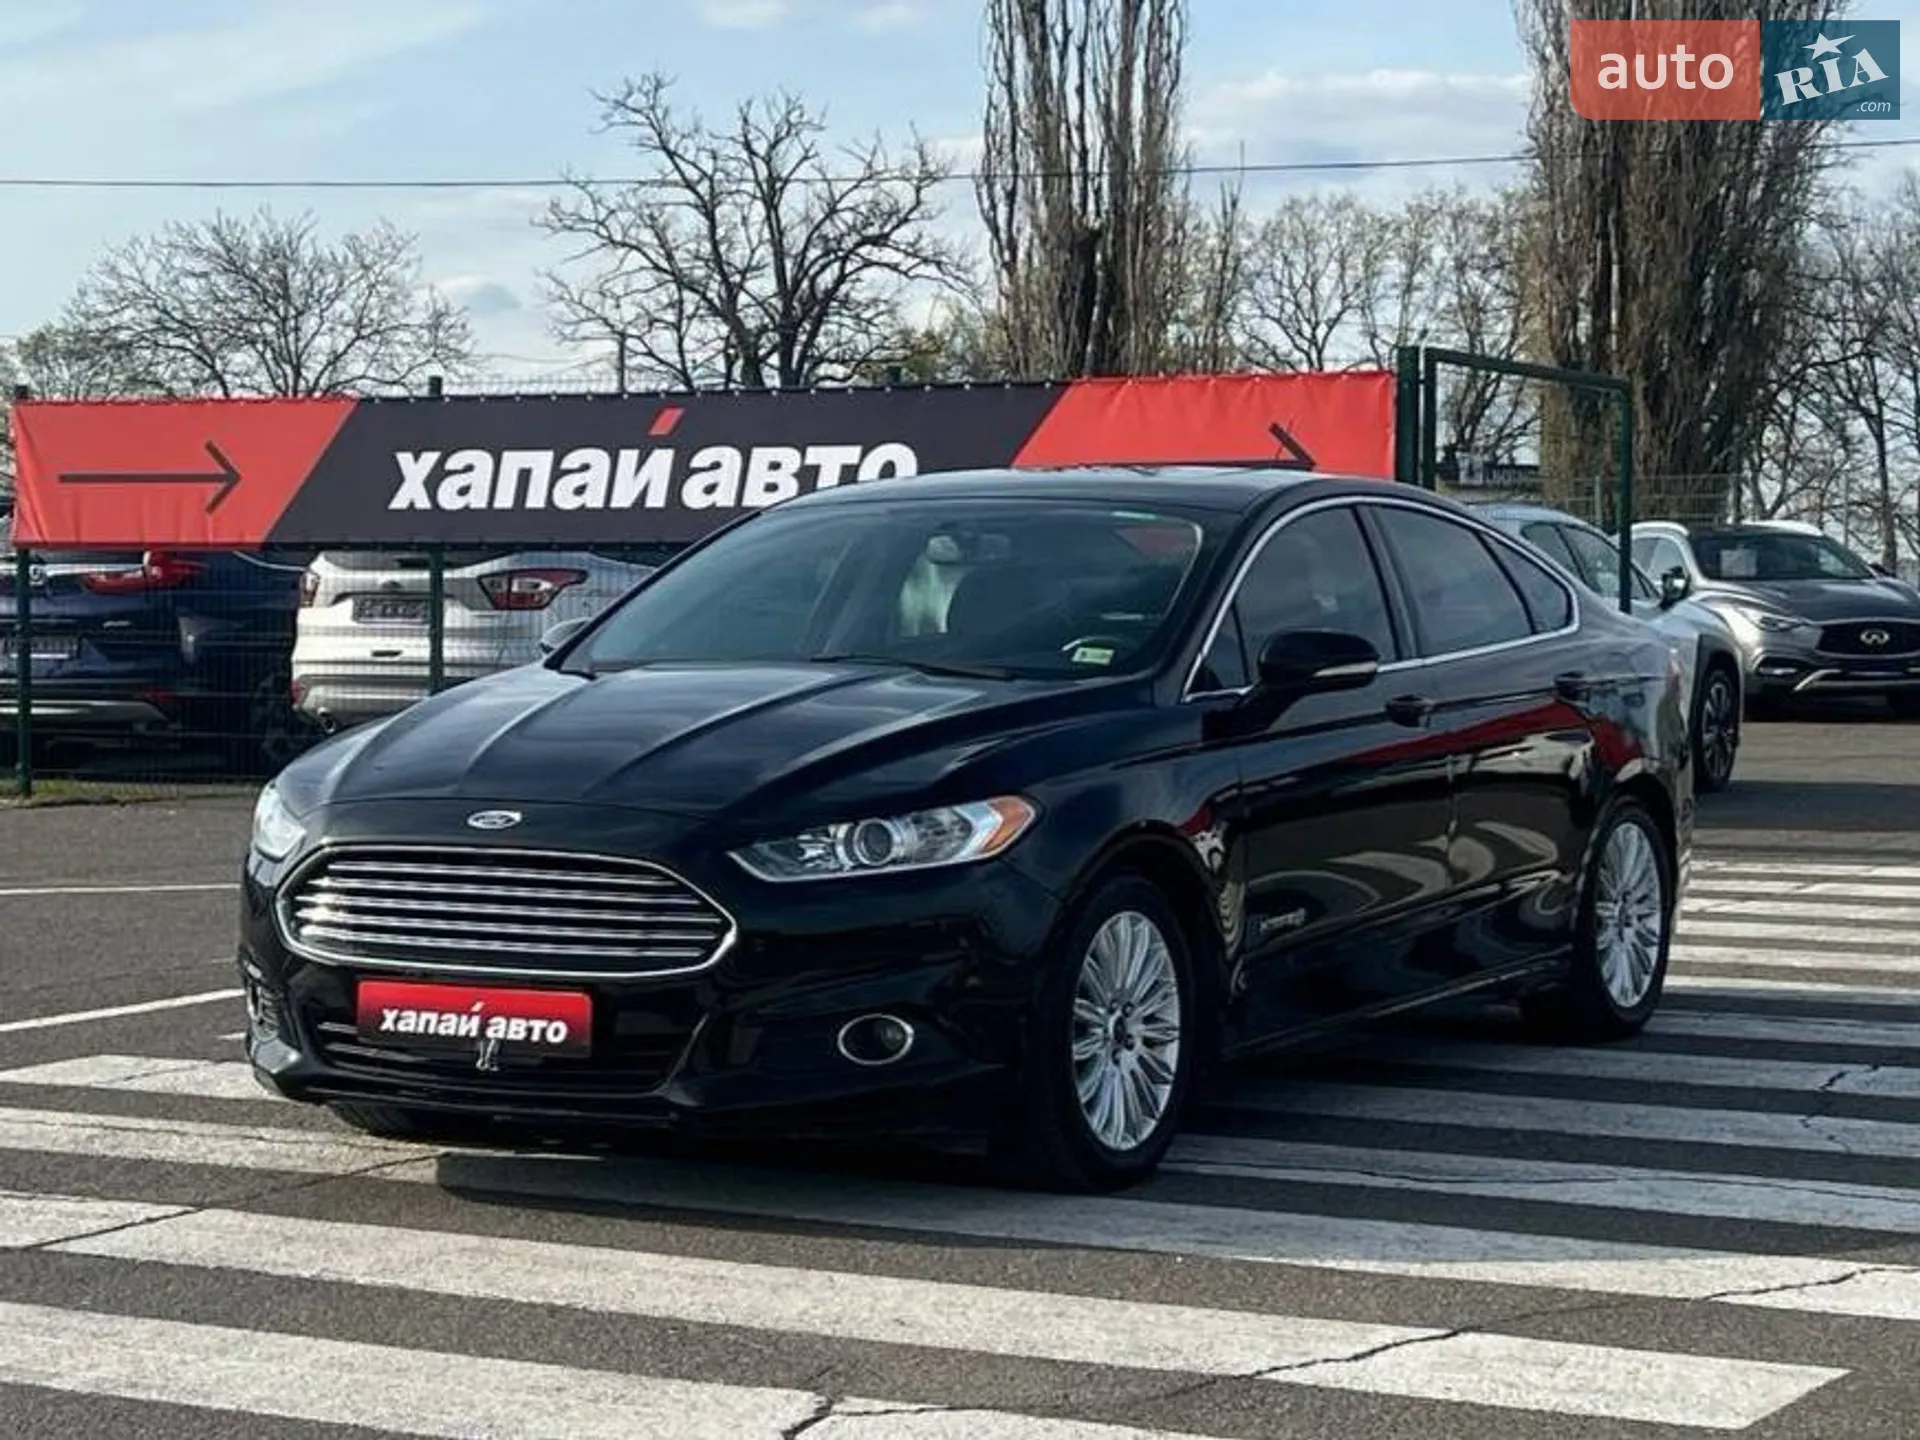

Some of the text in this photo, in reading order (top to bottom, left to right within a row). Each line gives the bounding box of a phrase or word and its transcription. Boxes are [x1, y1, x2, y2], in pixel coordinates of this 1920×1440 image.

[389, 407, 684, 511] хапай
[379, 1001, 569, 1044] хапай авто
